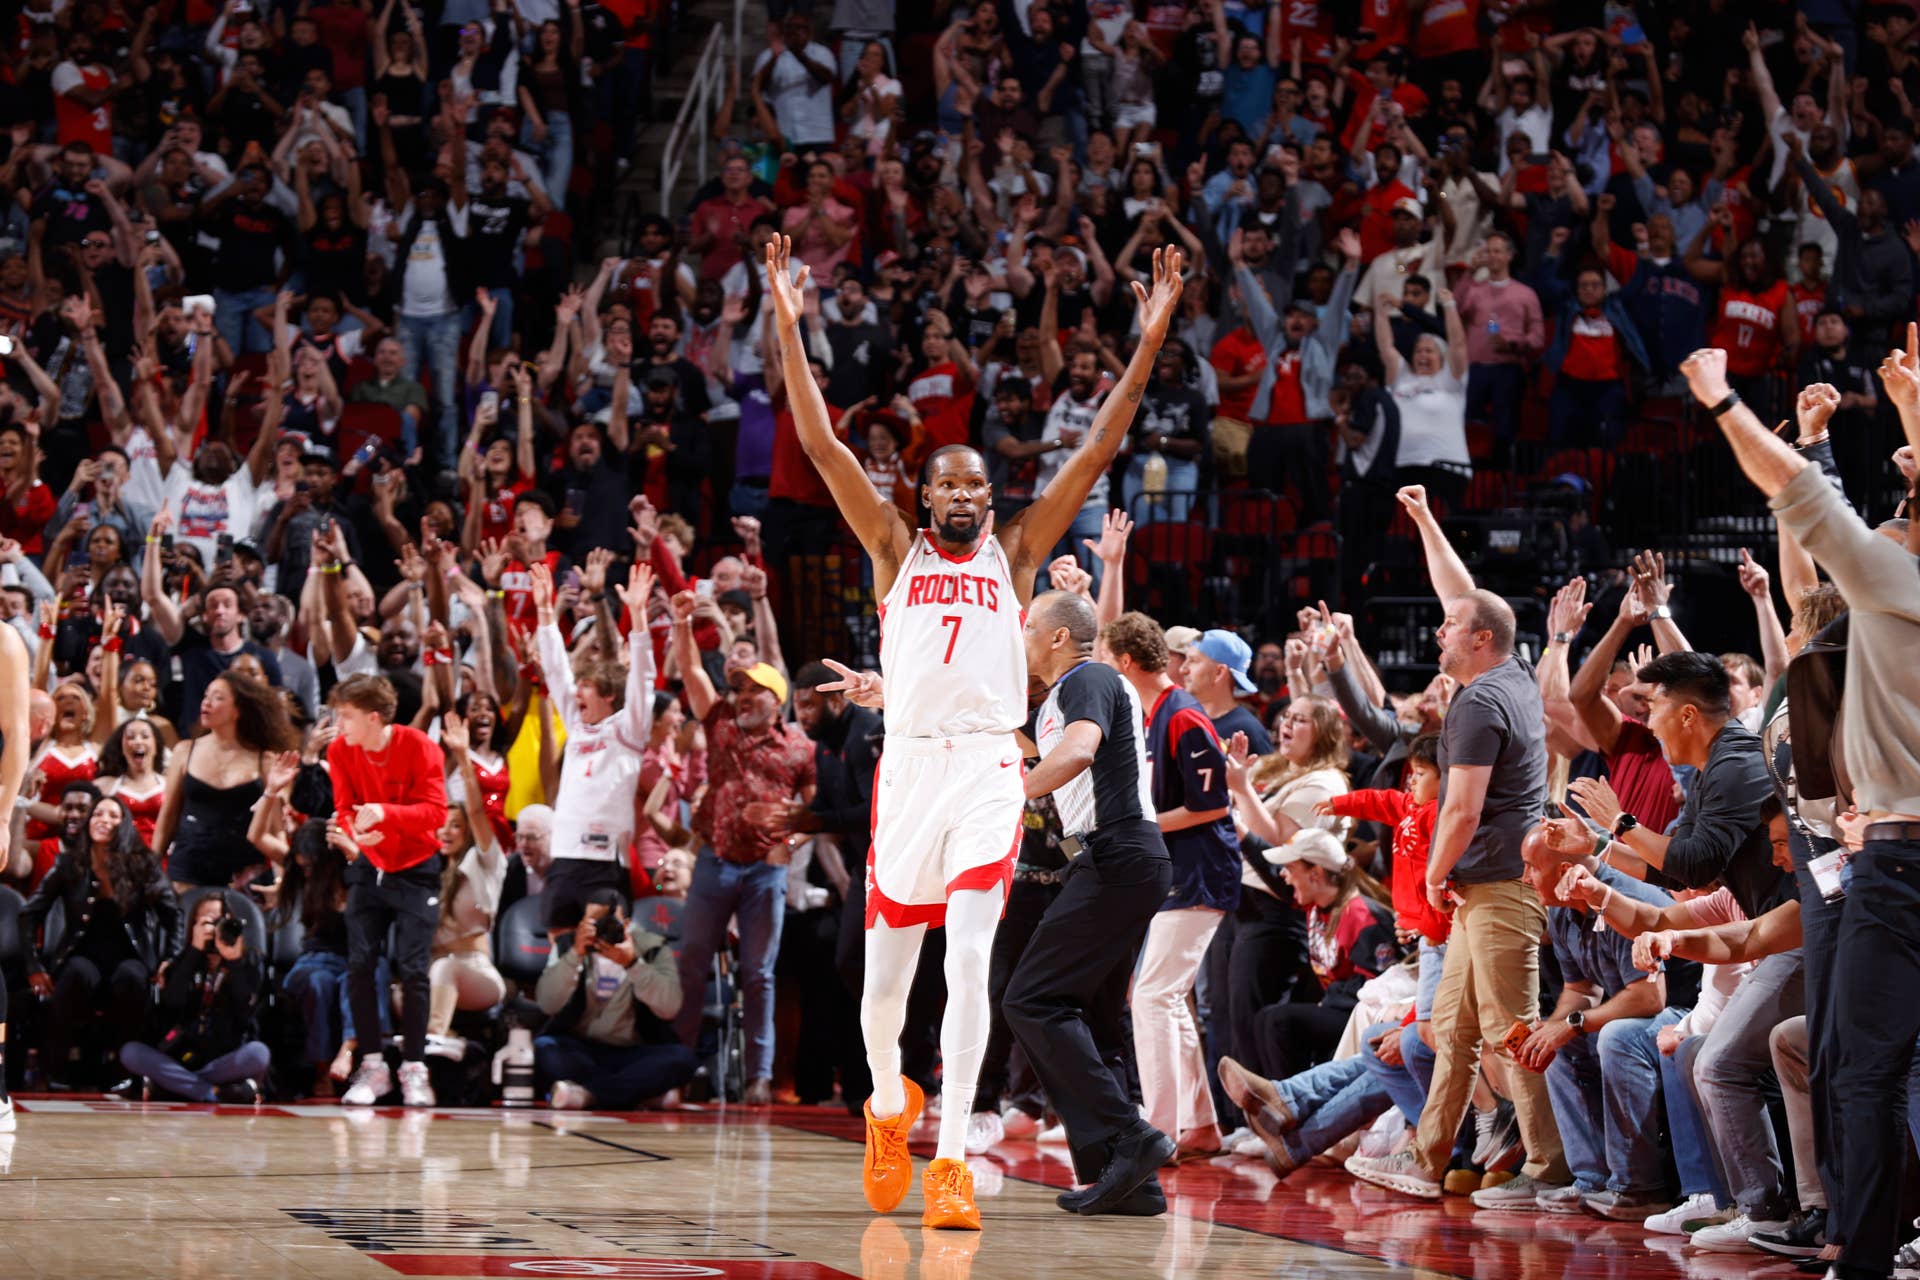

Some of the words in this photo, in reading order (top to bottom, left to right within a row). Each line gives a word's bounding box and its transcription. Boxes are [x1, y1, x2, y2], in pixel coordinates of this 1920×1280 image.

[511, 592, 527, 619] 7
[942, 615, 963, 664] 7
[1197, 768, 1214, 792] 7
